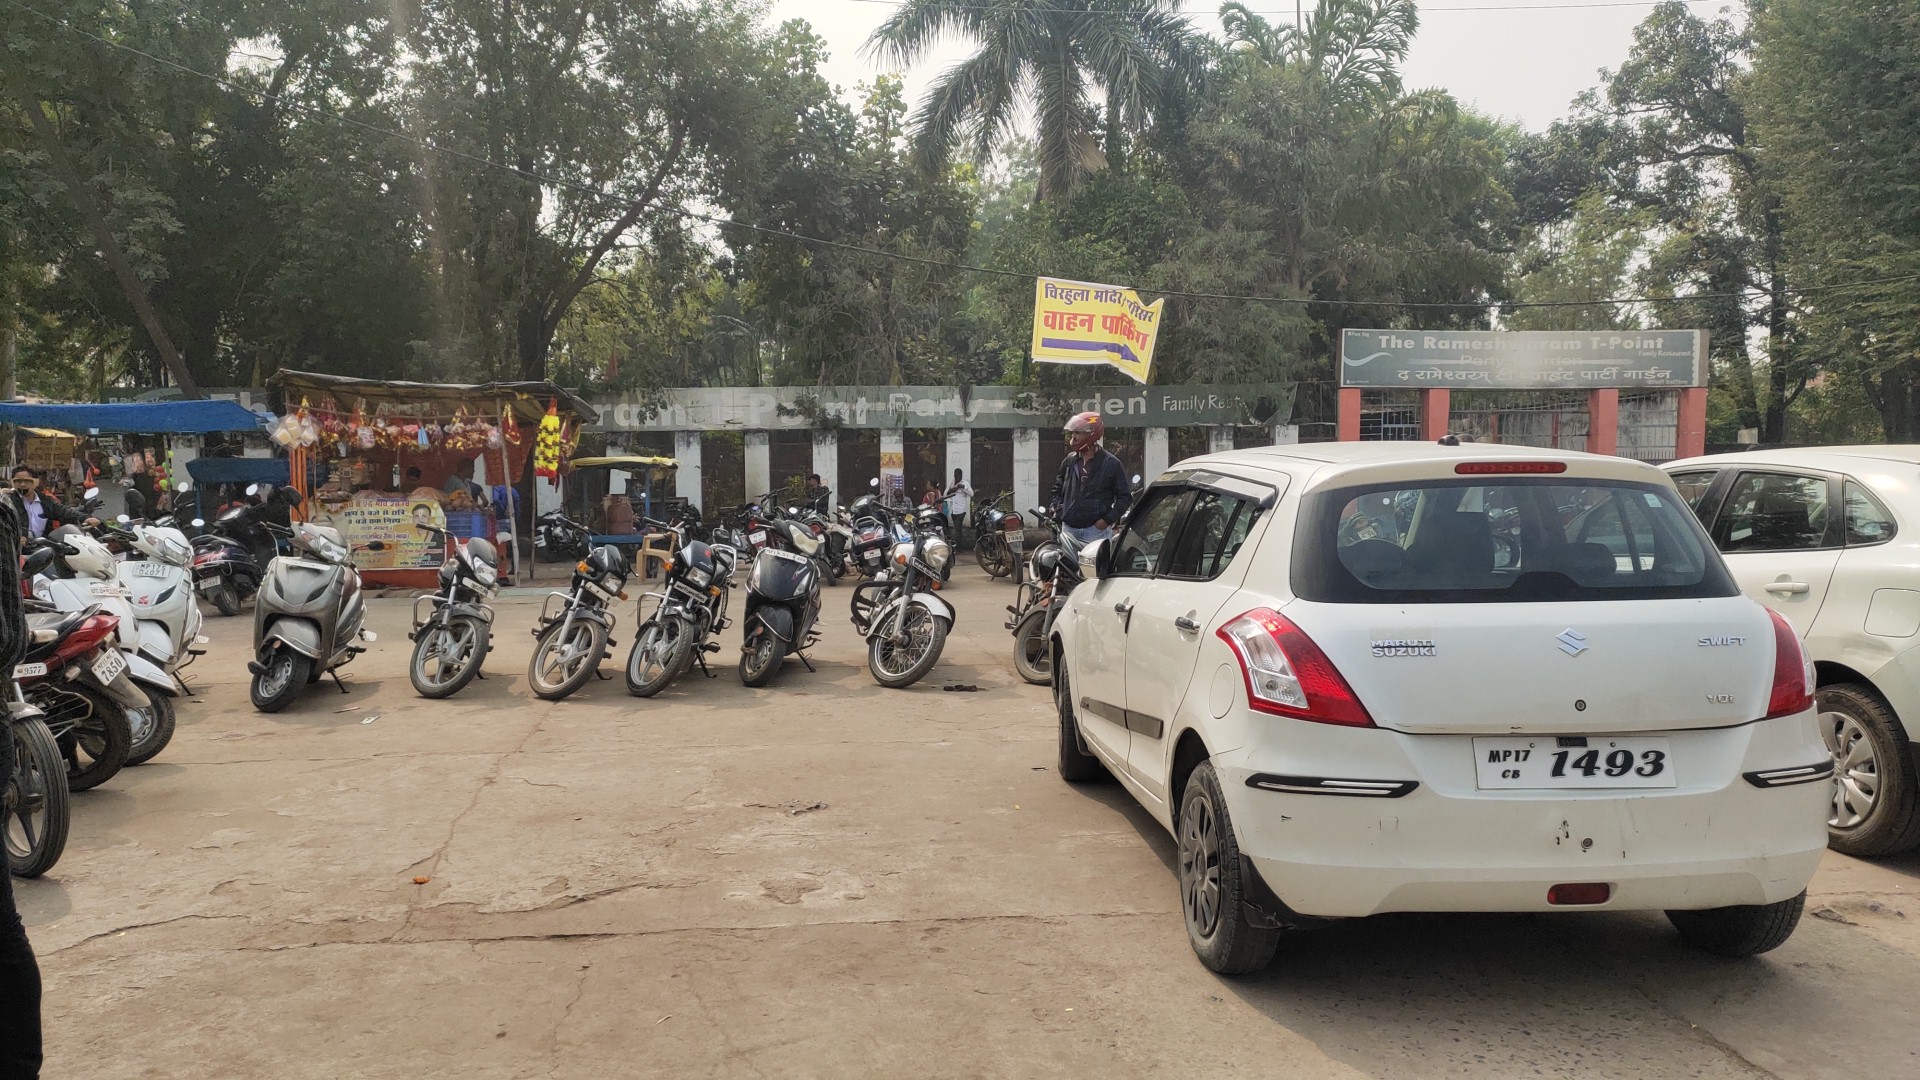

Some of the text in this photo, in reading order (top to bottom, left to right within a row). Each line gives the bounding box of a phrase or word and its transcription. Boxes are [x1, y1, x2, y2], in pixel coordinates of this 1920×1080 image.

[1044, 283, 1091, 305] चिरहुला
[1043, 310, 1097, 332] वाहन
[1378, 335, 1665, 350] The Ramesharam T-Point
[1397, 369, 1411, 381] द
[1581, 367, 1619, 381] पार्टी
[1622, 366, 1673, 381] गार्डन
[889, 393, 985, 422] Party
[1011, 391, 1147, 416] Grden
[1162, 394, 1205, 414] Family
[1370, 639, 1436, 648] MARUTI
[1698, 635, 1746, 647] SWIFT
[1372, 647, 1437, 657] SUZUKI
[24, 665, 42, 675] 9577
[101, 657, 123, 682] 7850
[1488, 750, 1532, 763] MP17
[1550, 749, 1666, 777] 1493
[1501, 769, 1521, 779] CB
